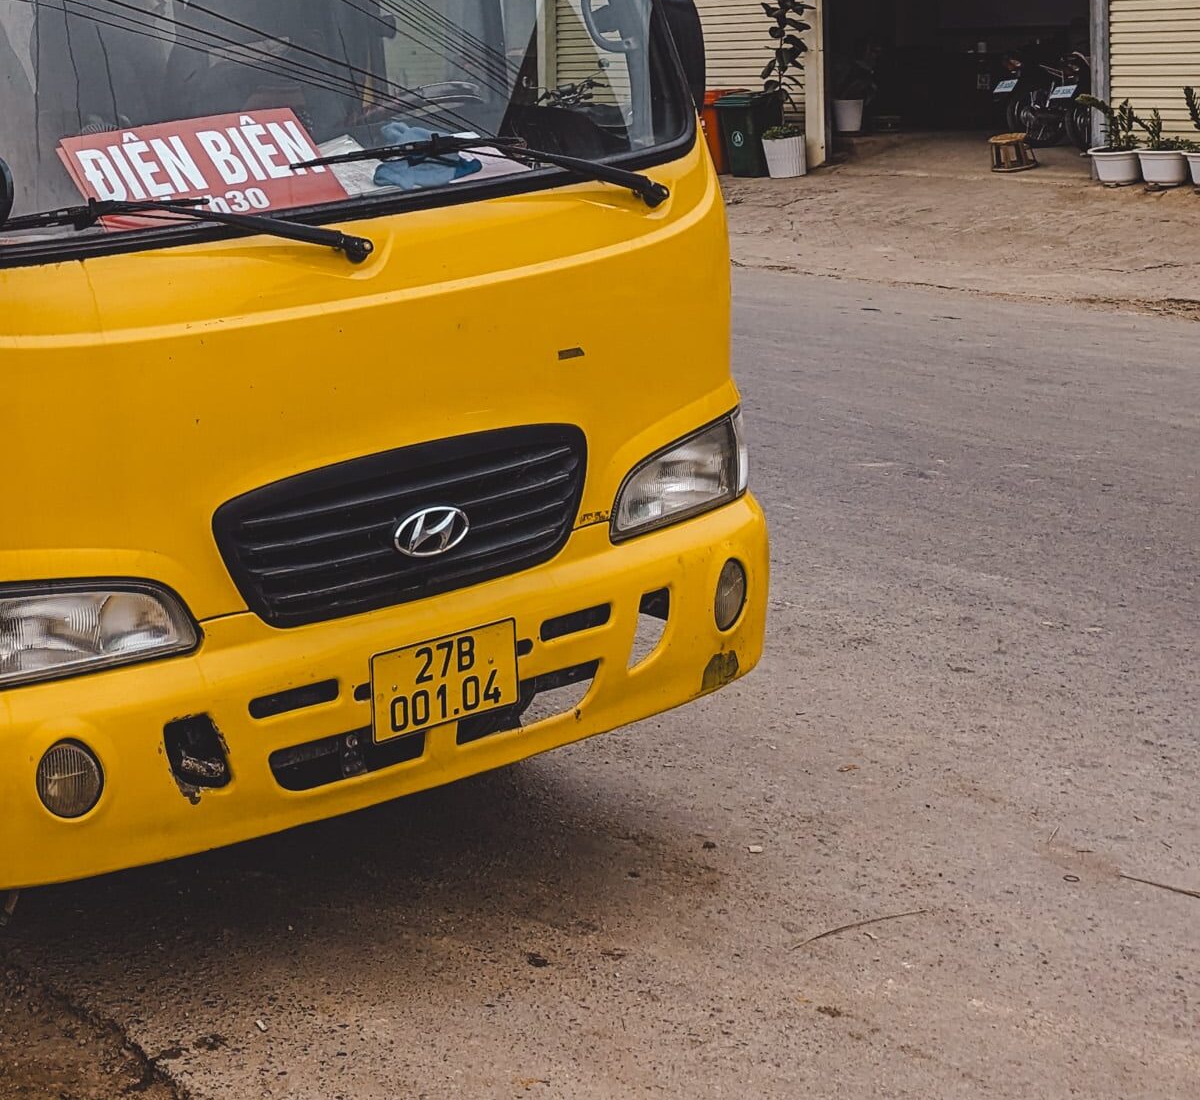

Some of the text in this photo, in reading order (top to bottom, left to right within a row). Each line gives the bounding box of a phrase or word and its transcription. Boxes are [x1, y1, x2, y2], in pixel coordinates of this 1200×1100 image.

[195, 114, 327, 186] BIÊN
[193, 186, 271, 215] h30
[414, 635, 475, 685] 27B
[390, 668, 502, 733] 001.04
